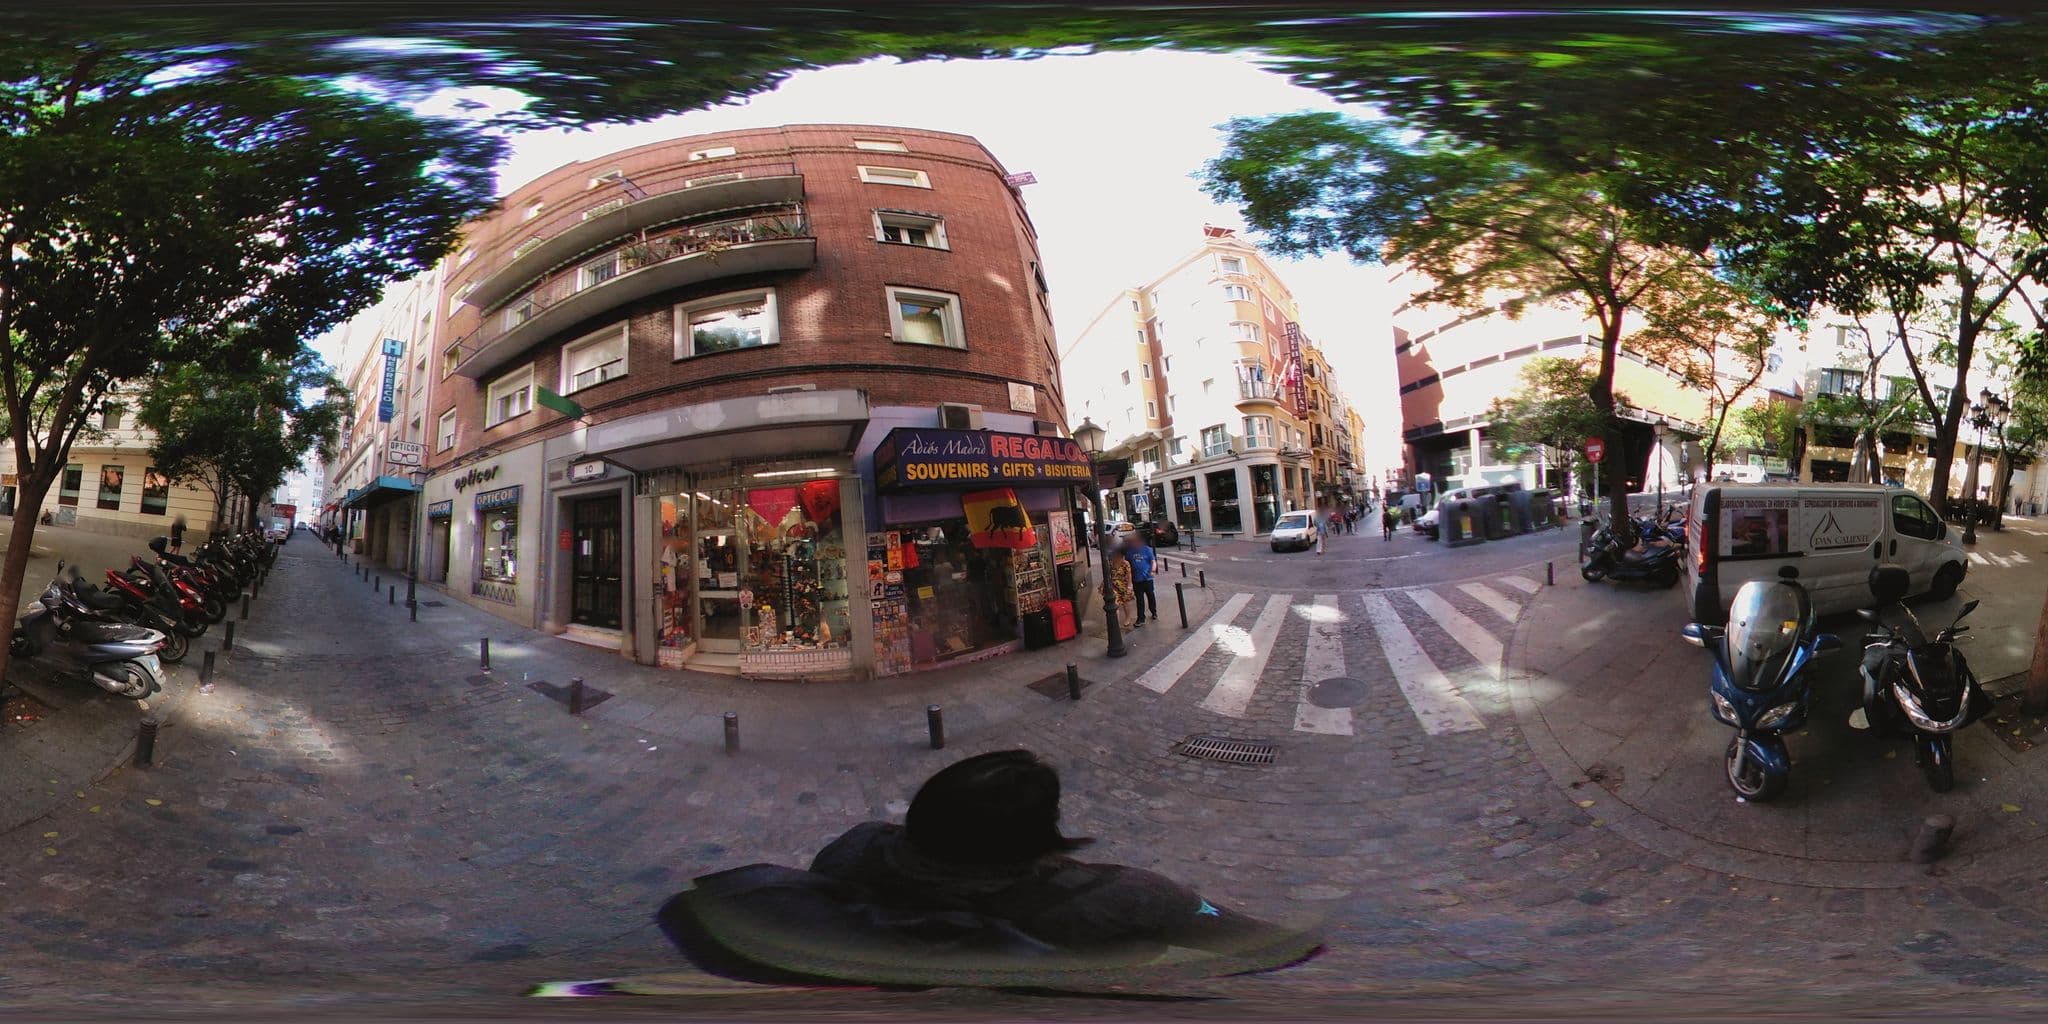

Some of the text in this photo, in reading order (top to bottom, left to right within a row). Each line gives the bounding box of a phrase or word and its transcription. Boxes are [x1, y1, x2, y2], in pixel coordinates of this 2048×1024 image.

[383, 339, 402, 357] H
[390, 442, 420, 452] OPTICOR
[942, 434, 986, 456] Madrid
[584, 464, 594, 474] 10
[906, 462, 1091, 480] SOUVENIRS GIFTS BISUTERIA
[455, 465, 499, 493] opticor
